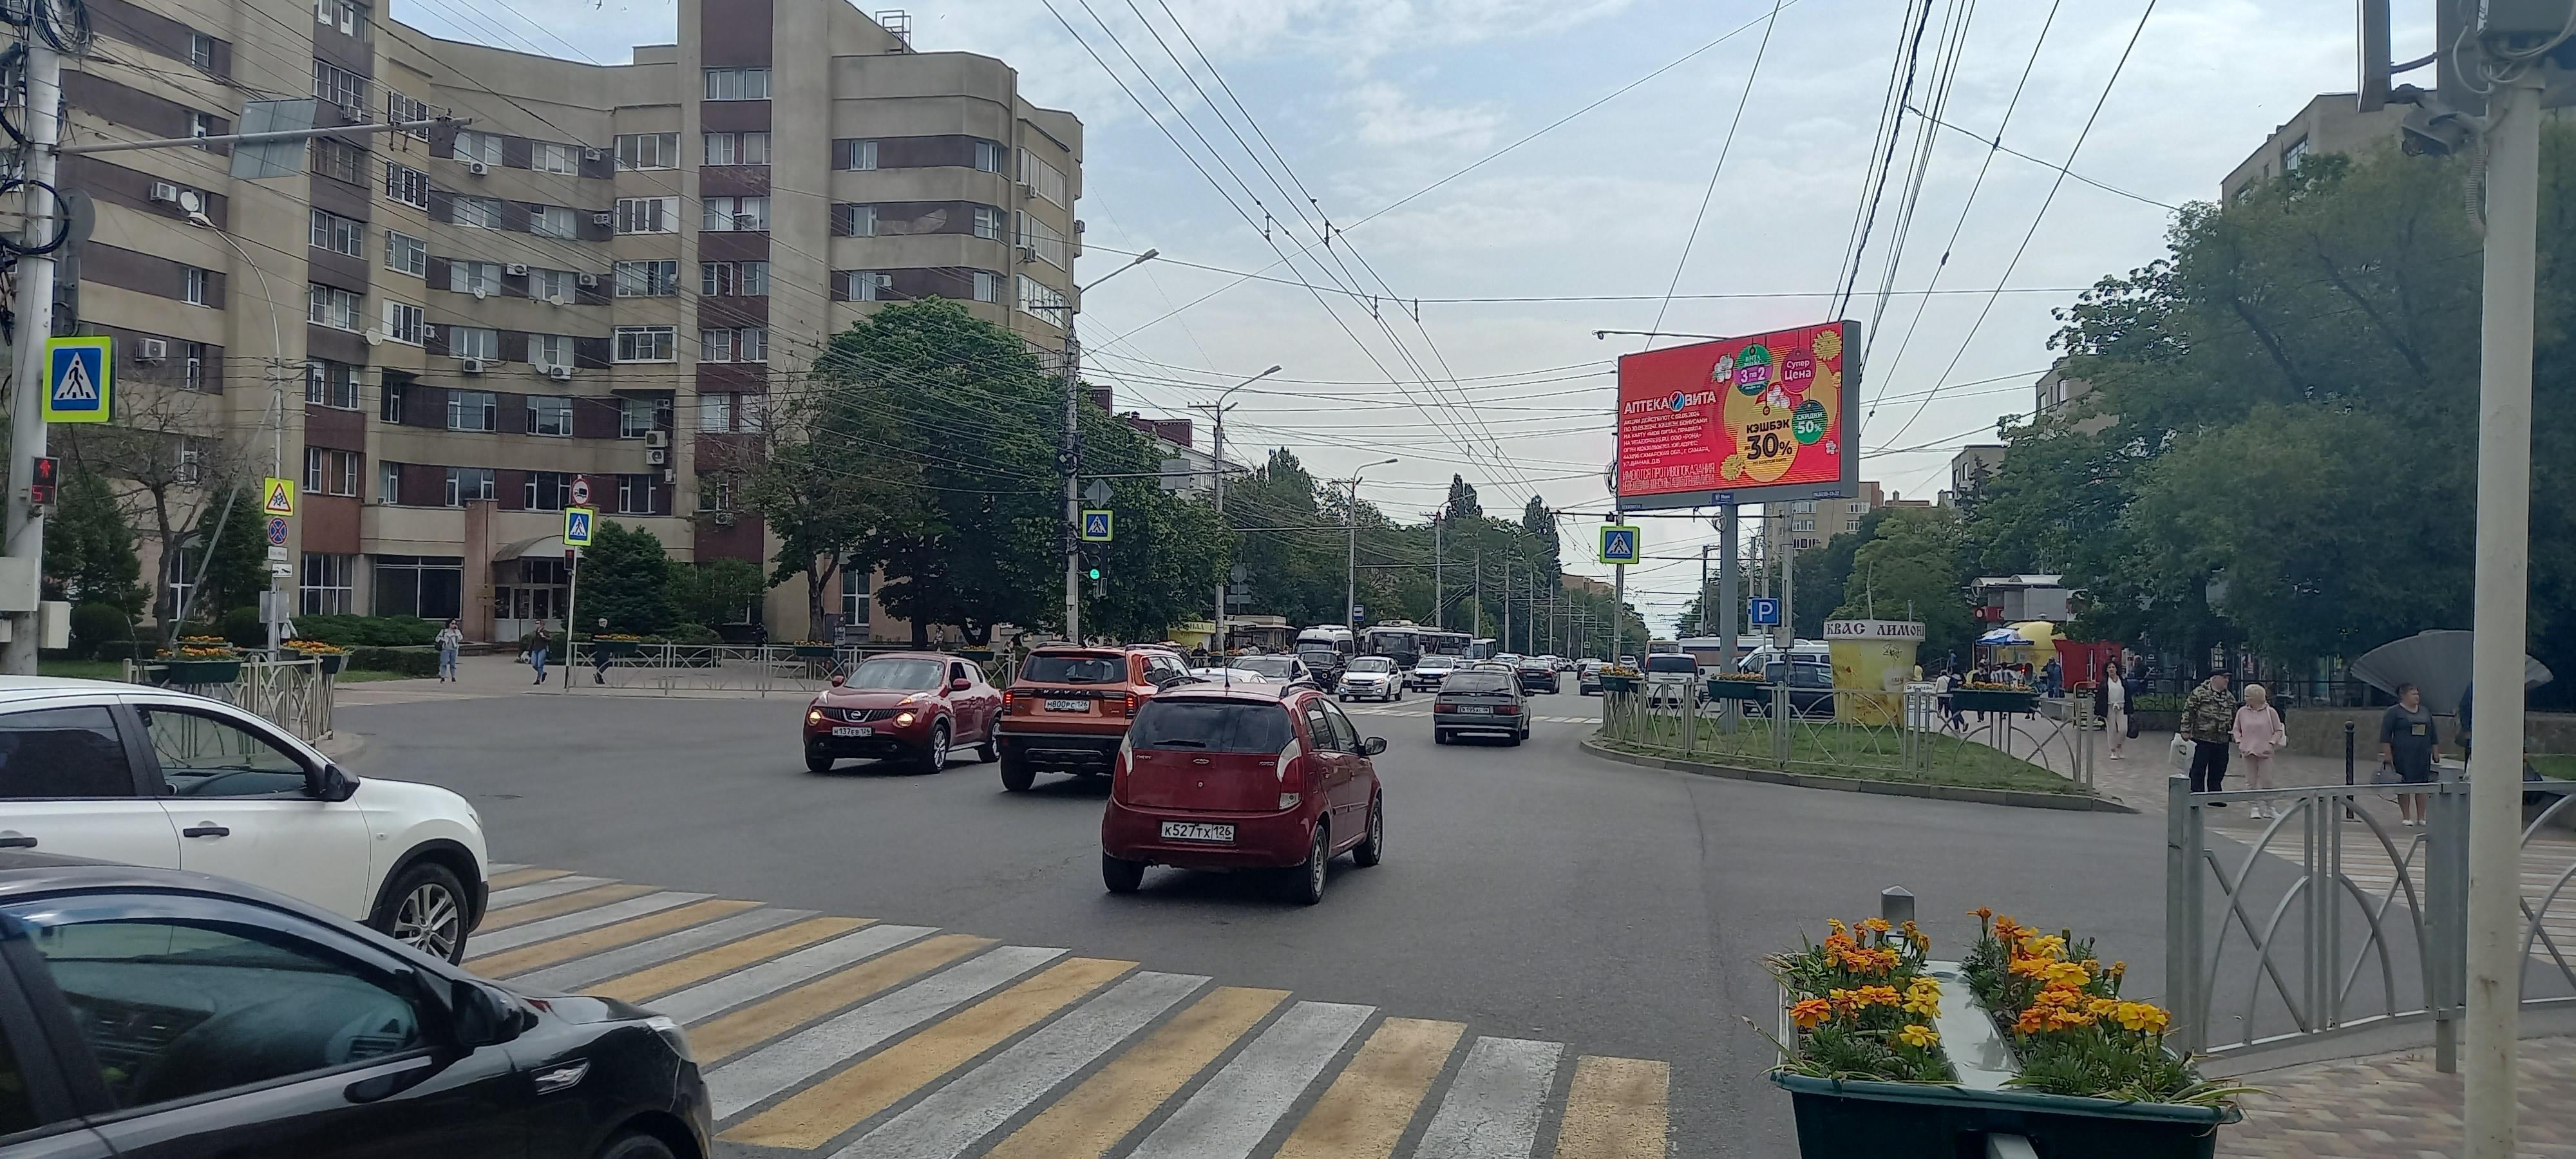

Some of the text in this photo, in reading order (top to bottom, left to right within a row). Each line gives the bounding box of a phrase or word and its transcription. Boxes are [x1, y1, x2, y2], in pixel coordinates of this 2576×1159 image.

[1786, 360, 1810, 369] Супер
[1741, 369, 1748, 382] 3
[1758, 367, 1766, 380] 2
[1785, 370, 1812, 381] Цена
[1624, 391, 1716, 415] АПТЕКА ВИТА
[1747, 419, 1790, 433] КЭШБЭК
[1797, 420, 1823, 434] 50%
[1747, 433, 1793, 460] 30%
[33, 485, 54, 501] 57
[1759, 601, 1773, 622] P
[1826, 623, 1866, 634] КВАС
[1164, 824, 1230, 838] К527ТХ 126
